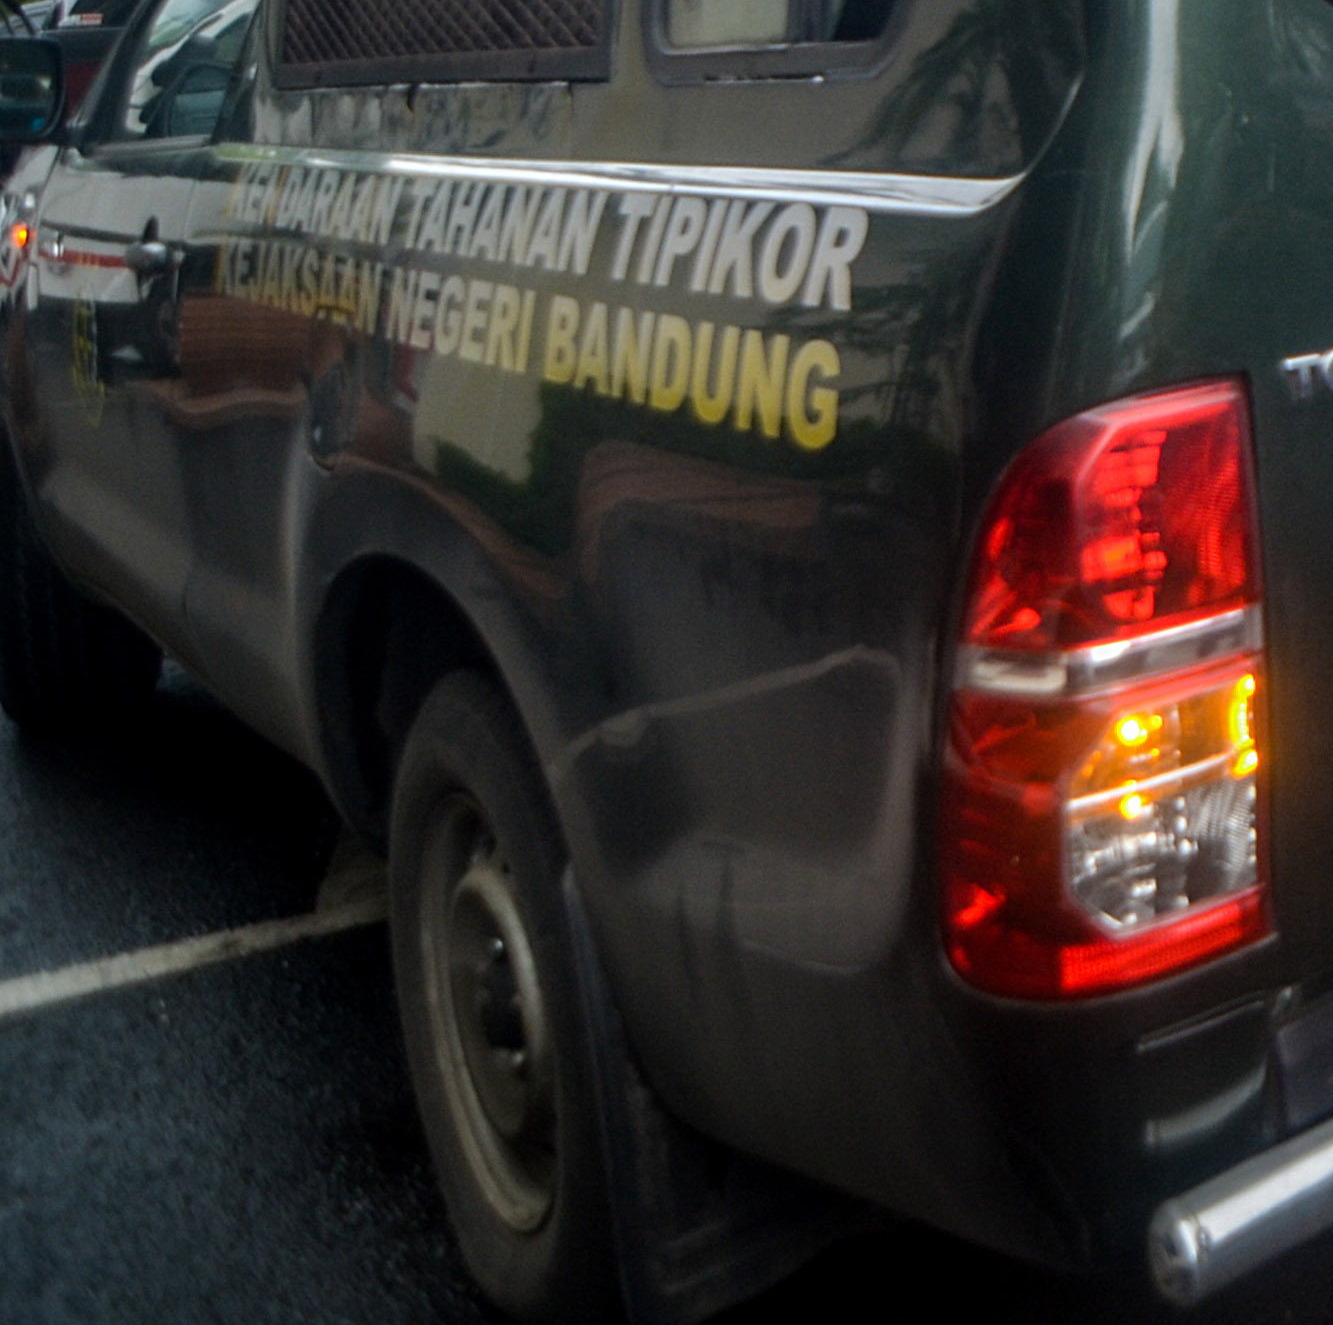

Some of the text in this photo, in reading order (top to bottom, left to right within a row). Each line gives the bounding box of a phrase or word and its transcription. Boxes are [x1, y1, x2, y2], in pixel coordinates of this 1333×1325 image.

[406, 178, 609, 276] TAHANAN
[611, 192, 869, 311] TIPIKOR
[384, 264, 536, 373] NEGERI
[544, 293, 842, 451] BANDUNG
